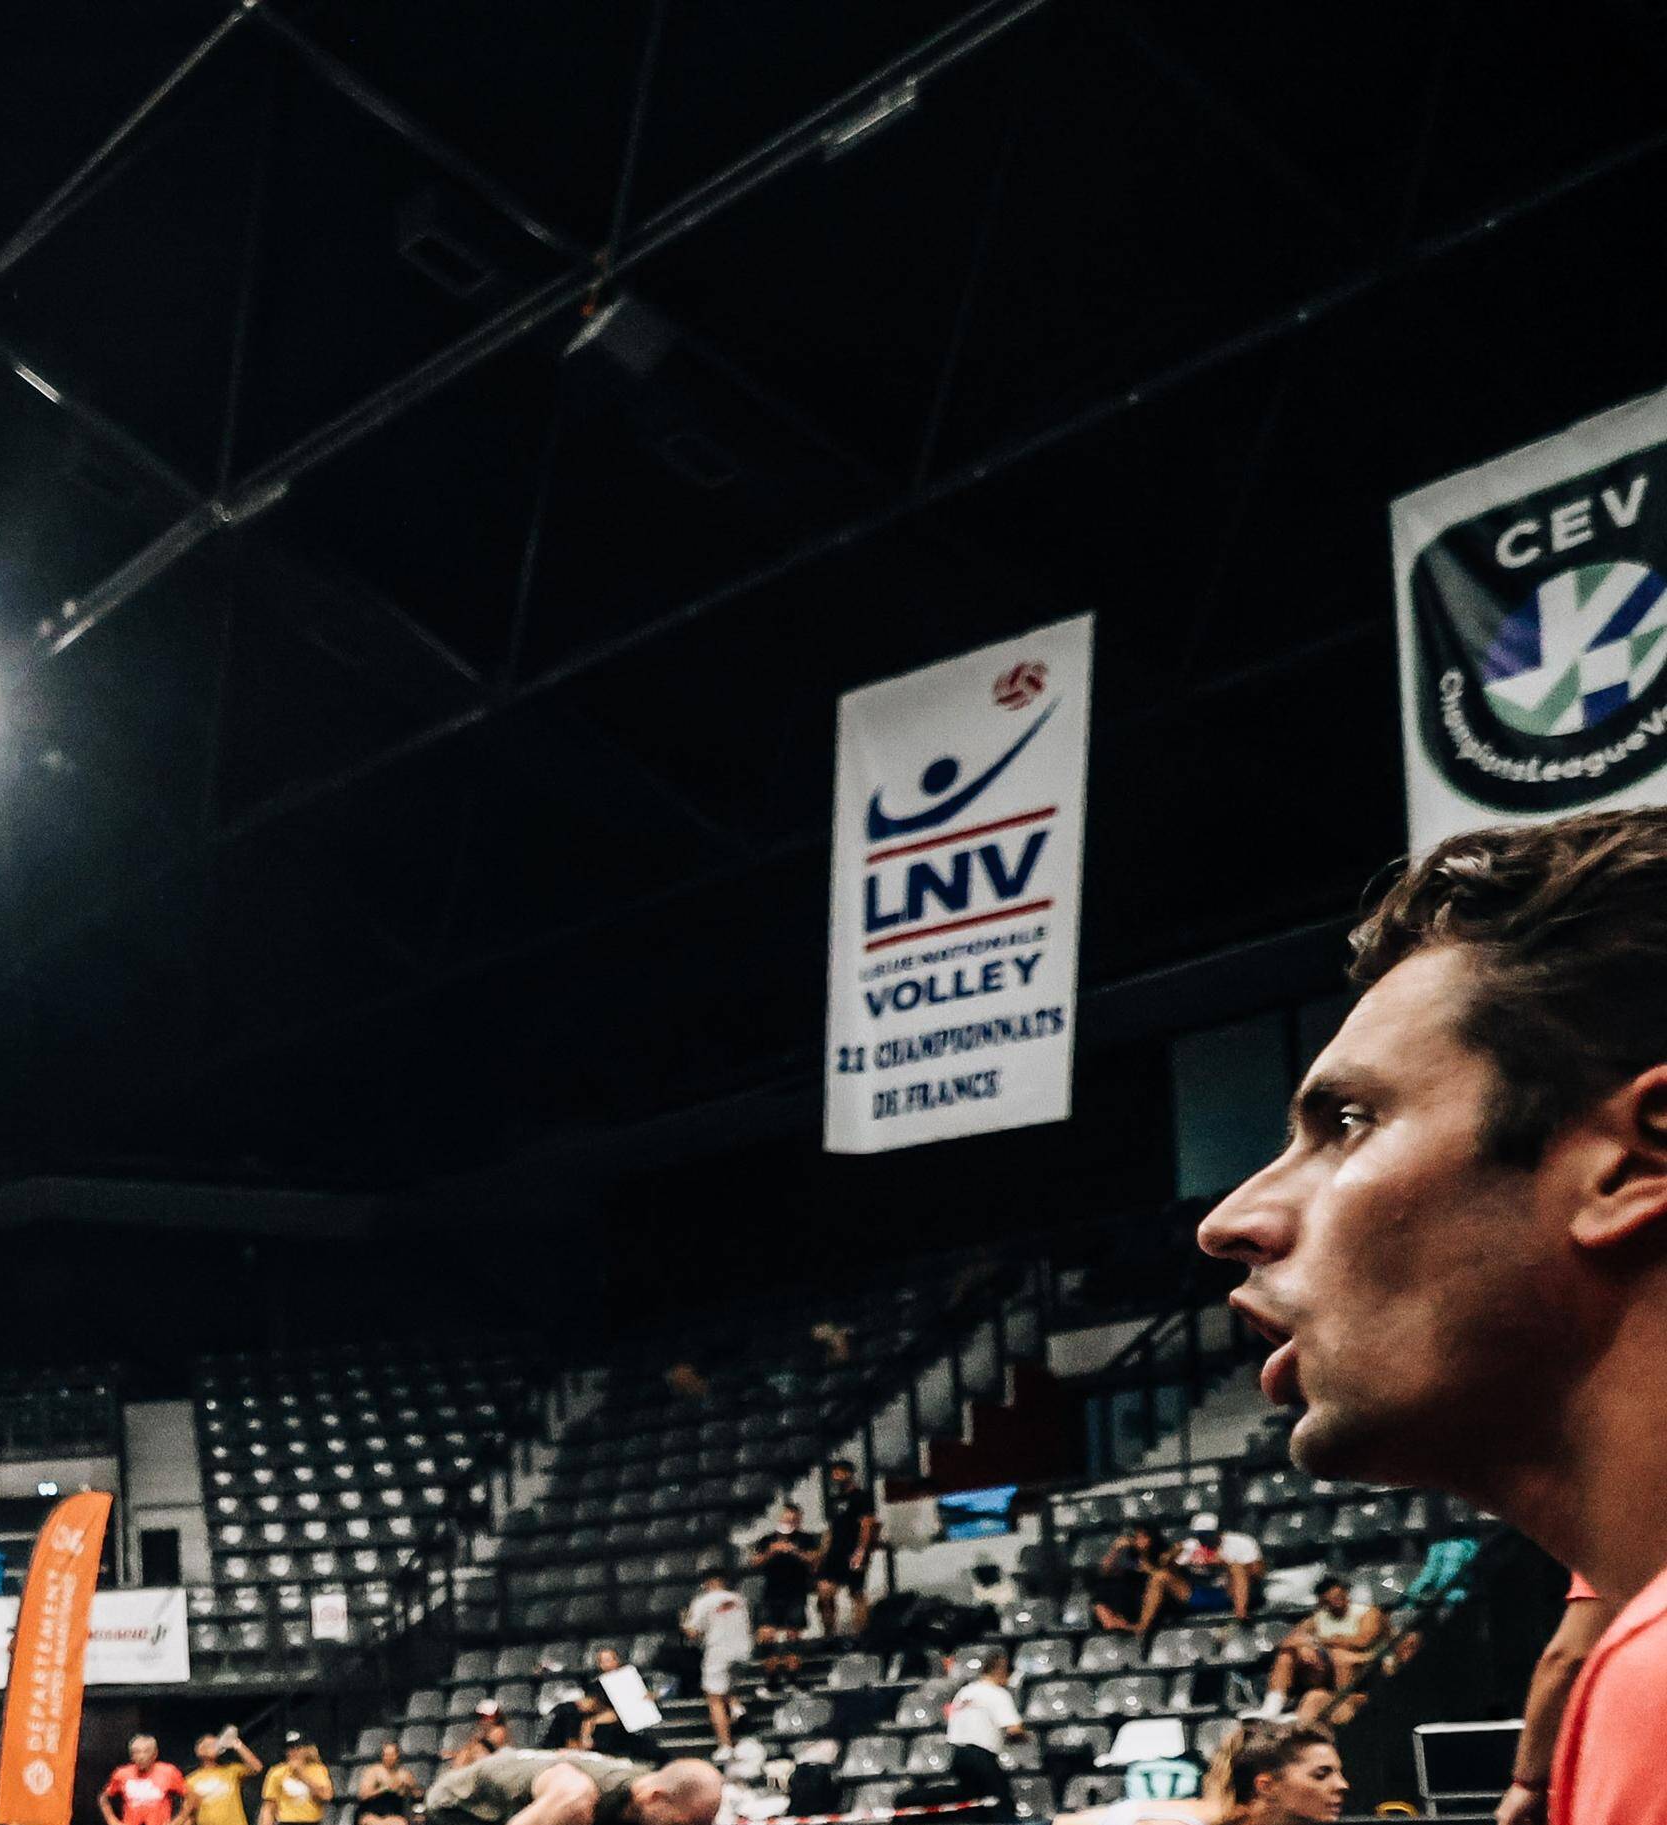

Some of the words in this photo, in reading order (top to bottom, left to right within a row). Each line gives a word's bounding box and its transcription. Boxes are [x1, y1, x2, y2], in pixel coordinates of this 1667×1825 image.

[1495, 474, 1650, 570] CEV
[863, 828, 1051, 934] LNV
[865, 952, 1043, 1019] VOLLEY
